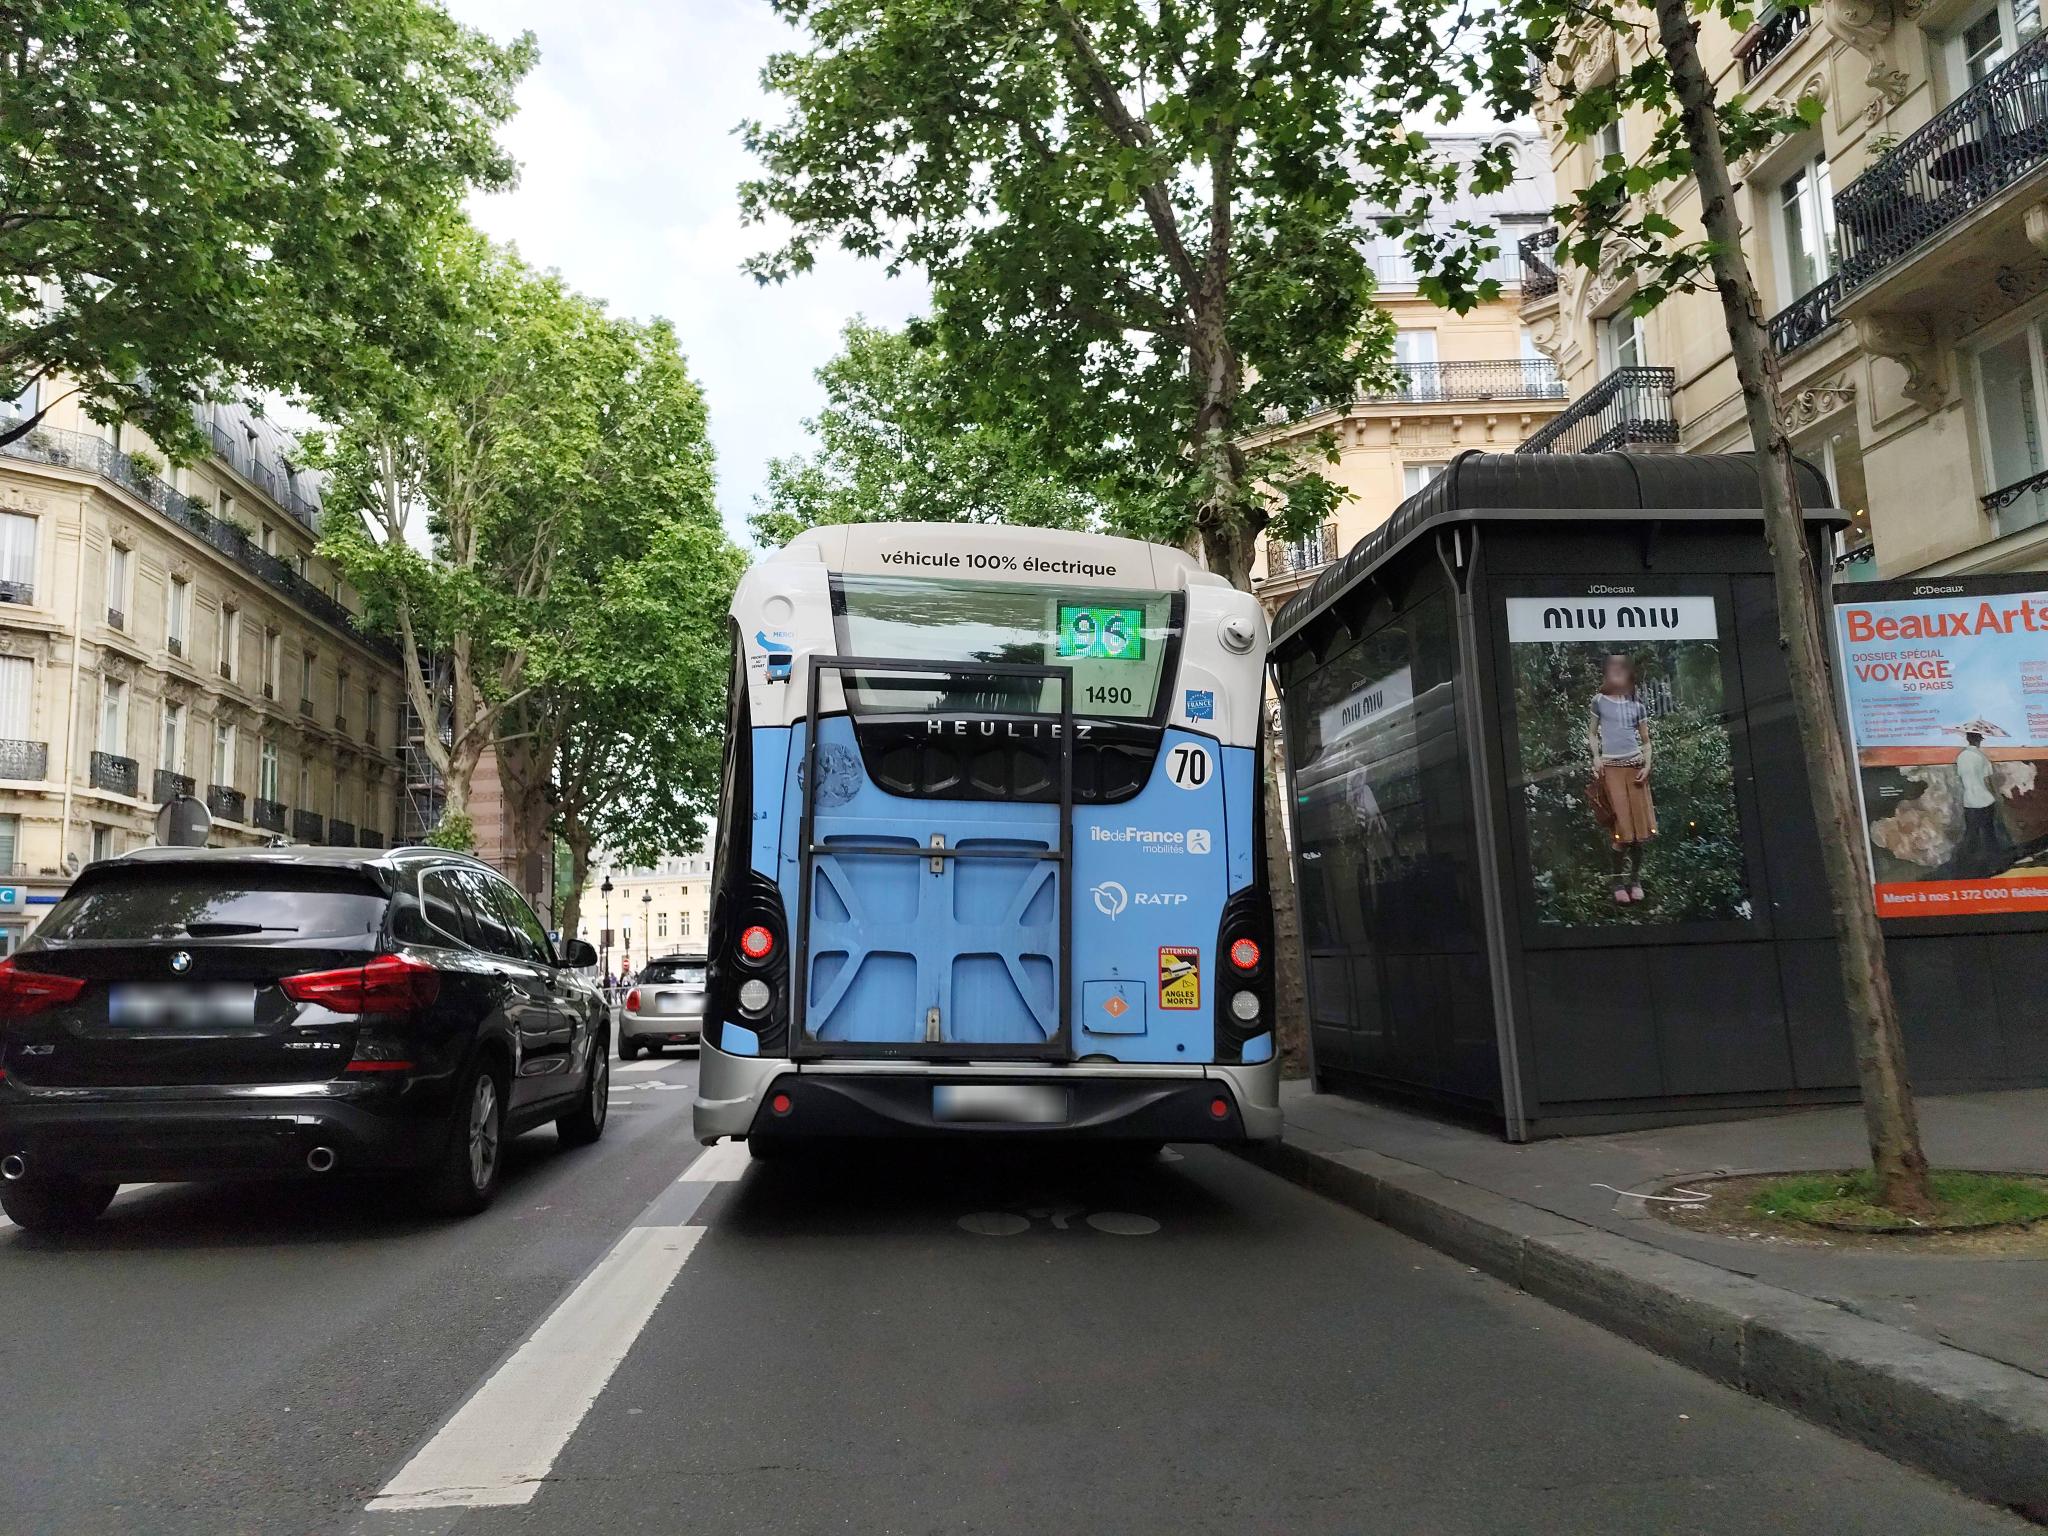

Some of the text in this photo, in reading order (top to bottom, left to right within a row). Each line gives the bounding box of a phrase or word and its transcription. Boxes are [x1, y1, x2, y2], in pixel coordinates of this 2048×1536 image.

[881, 551, 1117, 577] véhicule 100% électrique
[1587, 585, 1635, 594] JCDecaux
[1913, 585, 1964, 595] JCDecaux
[1073, 612, 1128, 654] 96
[1852, 648, 1944, 662] DOSSIER SPÉCIAL
[1854, 660, 1952, 683] VOYAGE
[1903, 681, 1954, 692] 50 PAGES
[1085, 686, 1132, 704] 1490
[927, 719, 1092, 739] HEULIEZ
[1175, 749, 1206, 785] 70
[1142, 844, 1184, 854] mobilités
[1134, 893, 1188, 905] RATP
[1883, 893, 1916, 903] Merci
[1919, 892, 1928, 902] à
[1929, 893, 1950, 902] nos
[1161, 947, 1198, 955] ATTENTION
[1166, 990, 1194, 998] ANGLES
